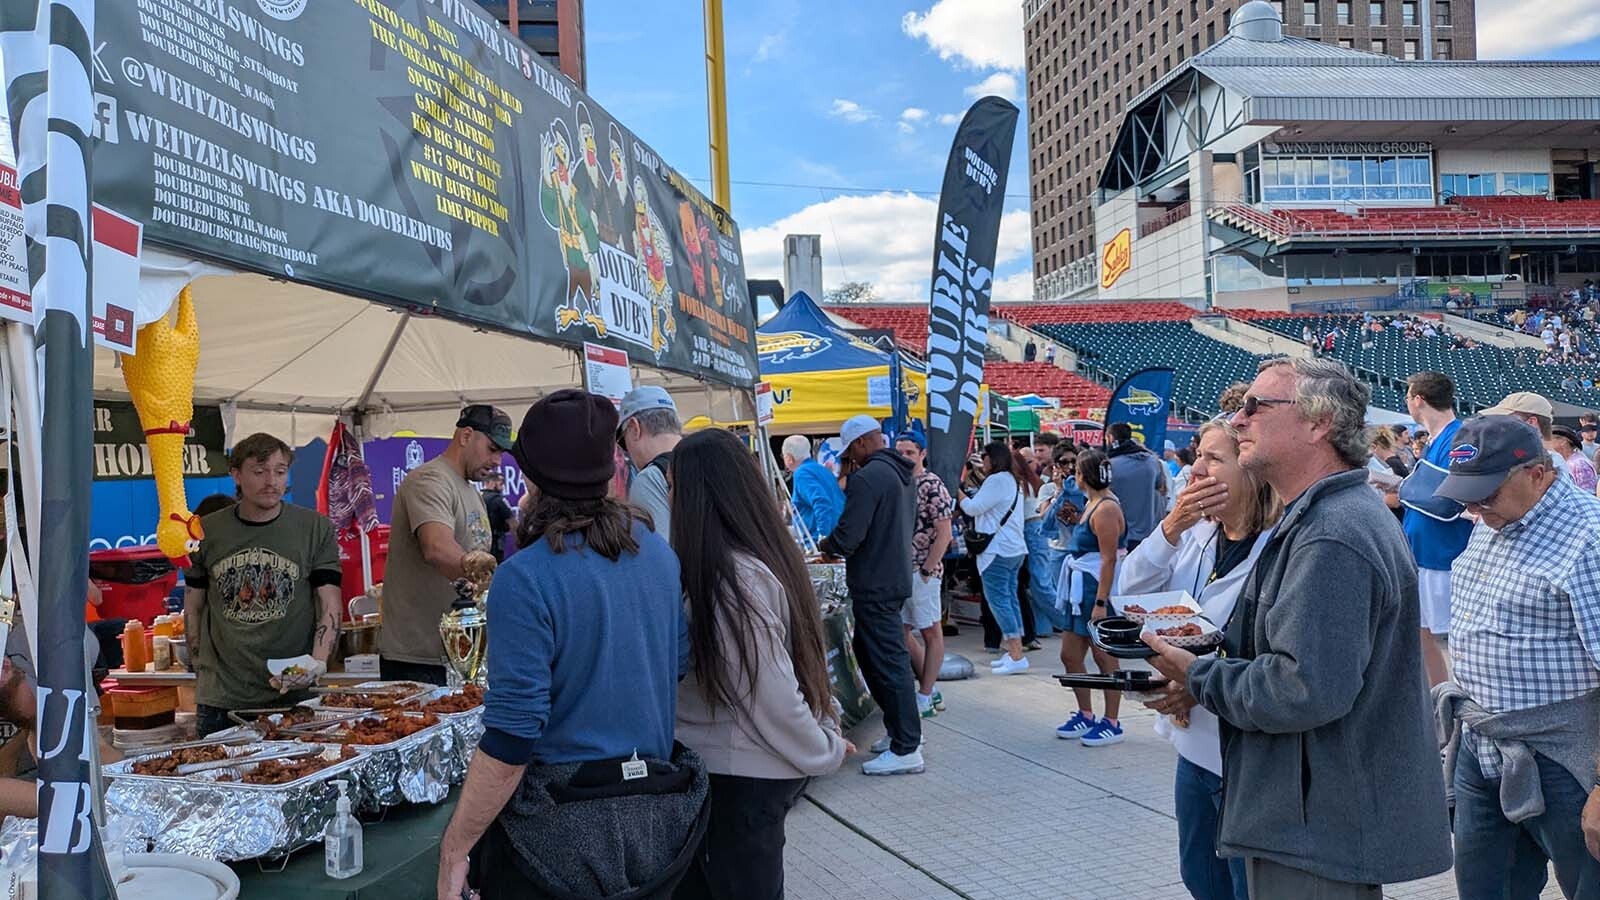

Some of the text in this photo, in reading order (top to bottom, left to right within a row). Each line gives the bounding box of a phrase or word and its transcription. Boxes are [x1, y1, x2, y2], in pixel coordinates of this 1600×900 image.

[369, 18, 398, 50] THE
[398, 38, 446, 81] CREAMY
[447, 67, 477, 104] PEACH
[426, 15, 459, 49] MENU
[440, 0, 572, 108] WINNER IN 5 YEARS
[400, 17, 429, 50] LOCO
[463, 60, 500, 100] BUFFALO
[500, 89, 523, 115] MILD
[121, 57, 317, 165] @WEITZELSWINGS
[407, 66, 496, 134] SPICY VEGETABLE
[415, 92, 496, 154] GARLIC ALFREDO
[423, 143, 497, 196] #17 SPICY BLEU
[433, 125, 453, 150] BIG
[453, 136, 476, 163] MAC
[476, 149, 502, 179] SAUCE
[965, 146, 999, 187] DOUBLE
[1281, 142, 1426, 154] WNY IMAGING GROUP
[124, 110, 306, 204] WEITZELSWINGS
[312, 185, 355, 219] AKA
[356, 198, 452, 251] DOUBLEDUBS
[154, 169, 251, 216] DOUBLEDUBSMKE
[445, 175, 488, 211] BUFFALO
[435, 194, 499, 238] LIME PEPPER
[611, 292, 650, 339] DUB'S
[927, 212, 969, 434] DOUBLE
[958, 257, 993, 417] DUB'S
